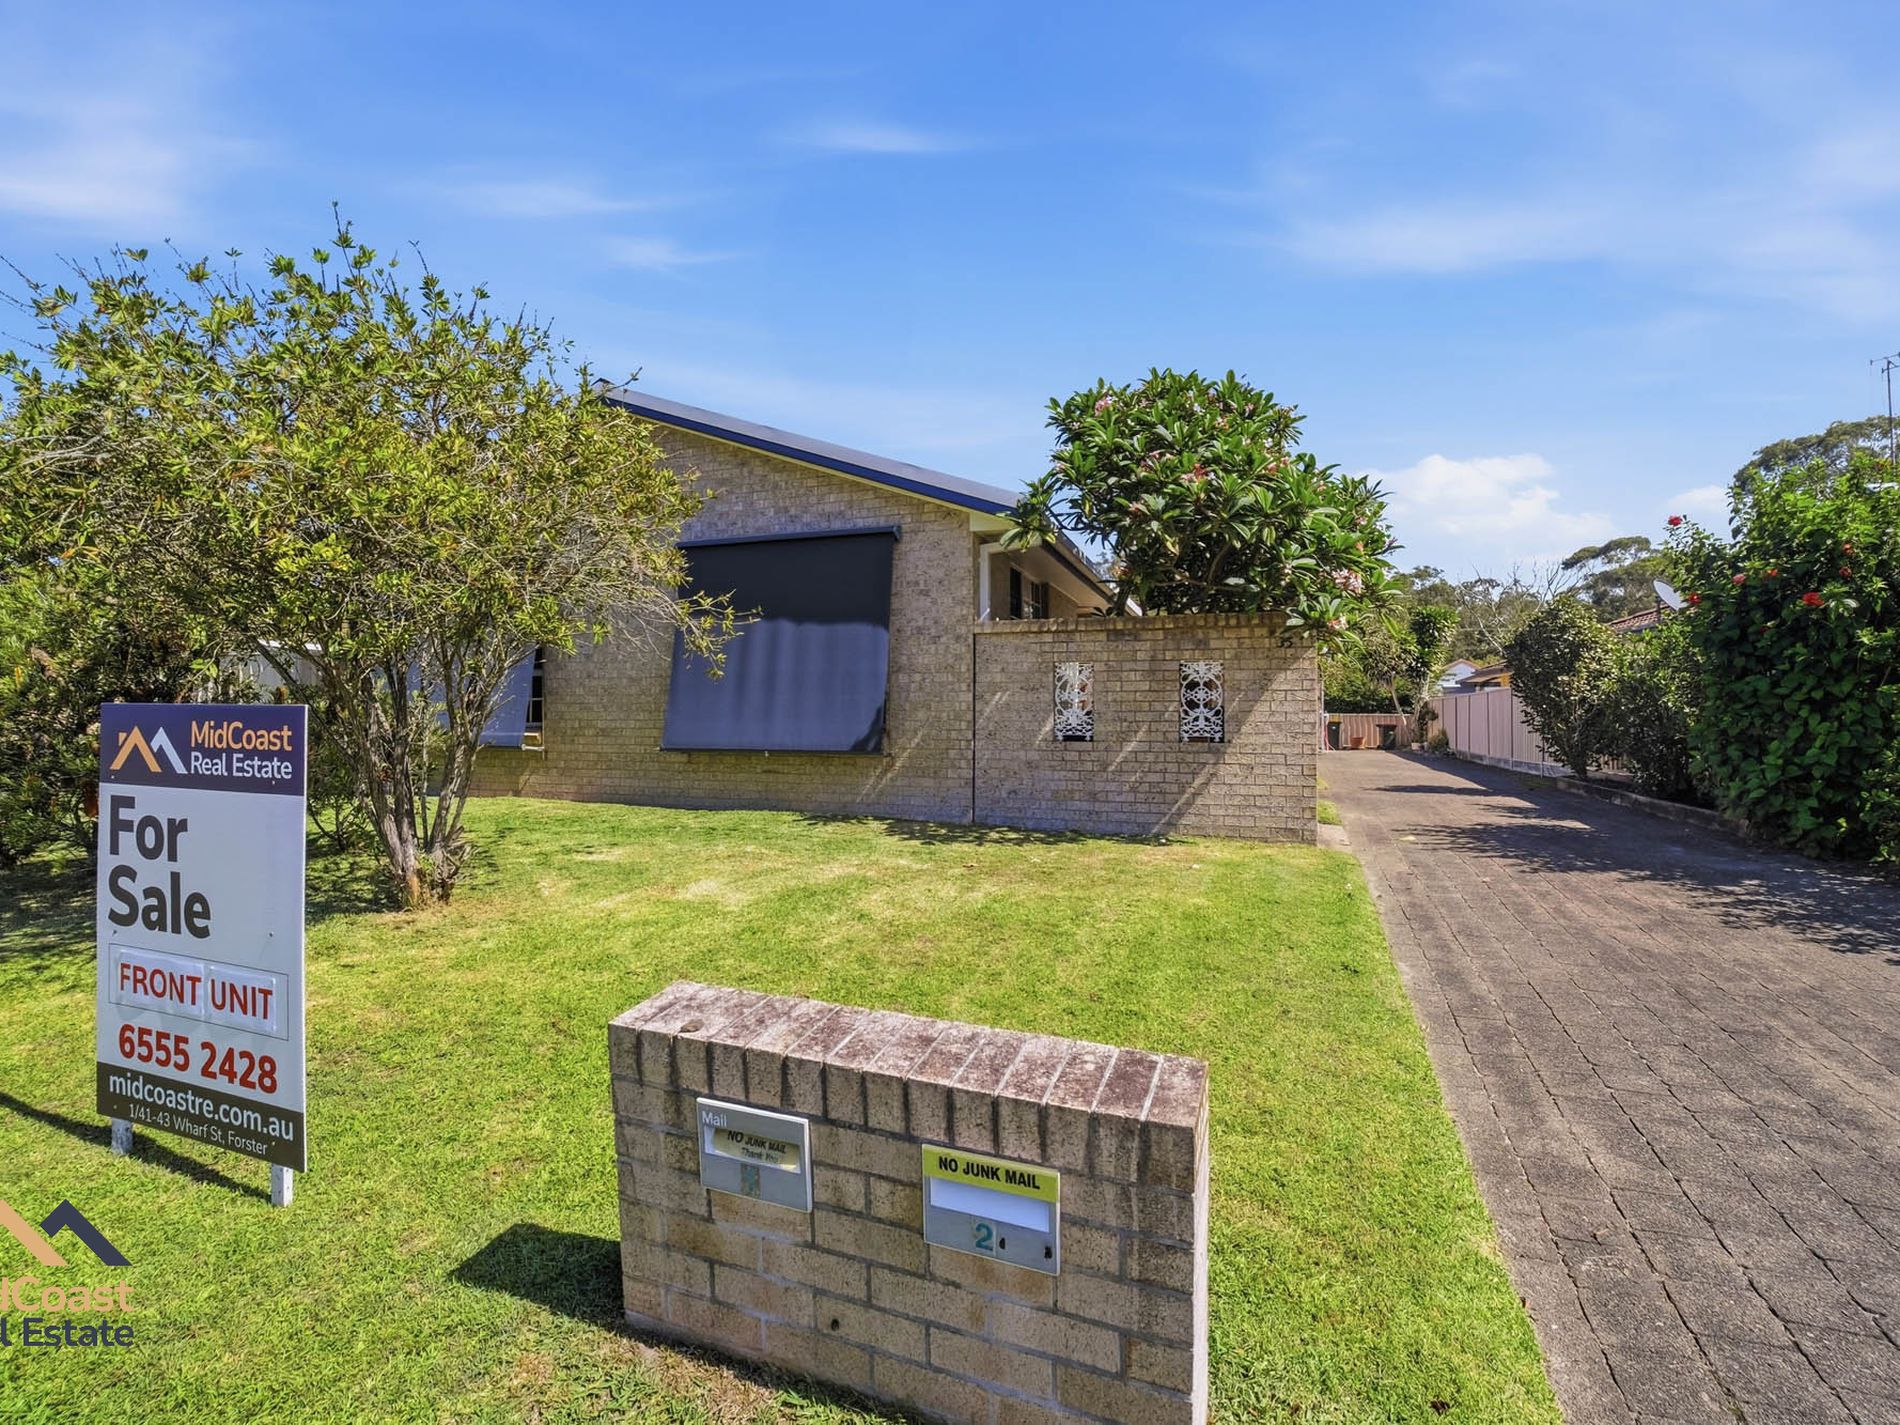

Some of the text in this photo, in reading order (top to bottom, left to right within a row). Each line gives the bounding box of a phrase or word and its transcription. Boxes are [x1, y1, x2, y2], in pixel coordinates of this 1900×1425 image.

[191, 720, 293, 751] MidCoast
[190, 751, 293, 779] Real Estate
[109, 794, 189, 863] For
[107, 864, 212, 939] Sale
[120, 963, 273, 1020] FRONT UNIT
[118, 1023, 278, 1094] 6555 2428
[109, 1072, 294, 1142] midcoastre.com.au
[702, 1110, 727, 1127] Mail
[129, 1103, 171, 1130] 1/41-43
[173, 1115, 209, 1139] Wharf
[228, 1131, 268, 1156] Forster
[727, 1130, 787, 1154] NO JUNK MAIL
[938, 1156, 1041, 1190] NO JUNK MAIL
[975, 1222, 994, 1252] 2
